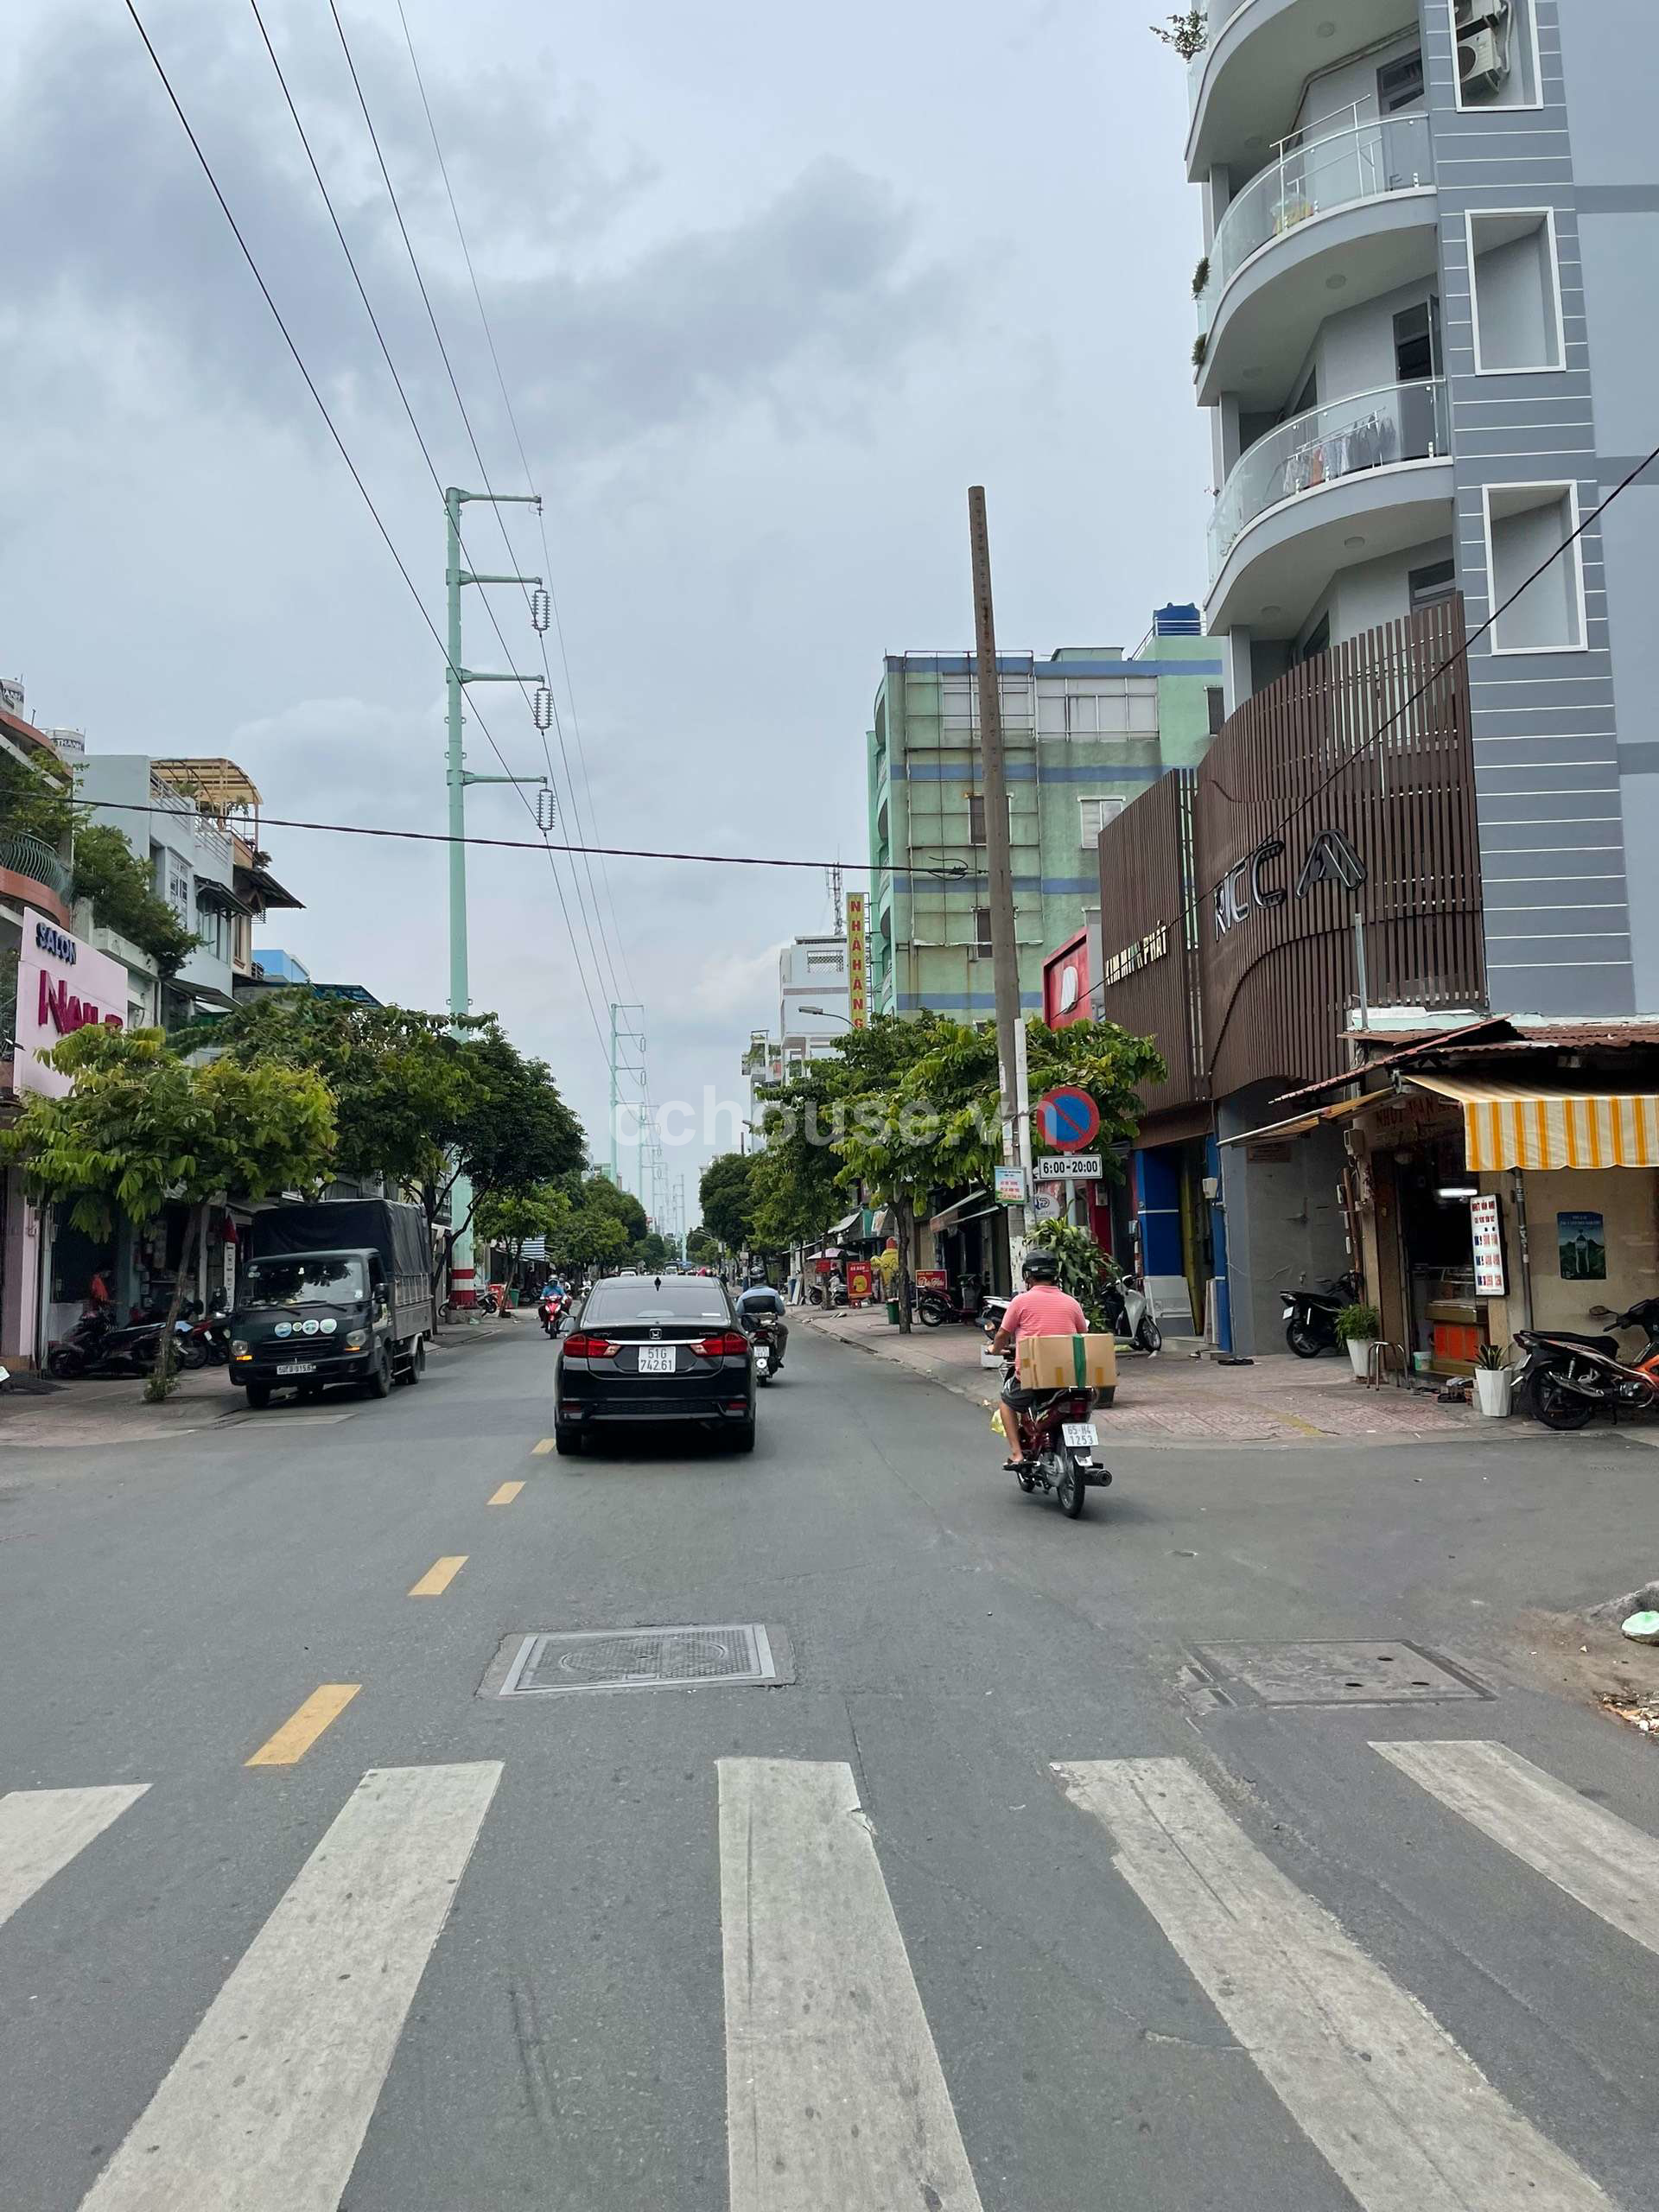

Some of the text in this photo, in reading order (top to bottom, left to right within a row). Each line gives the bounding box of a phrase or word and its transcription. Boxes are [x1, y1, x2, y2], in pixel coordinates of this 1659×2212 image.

[35, 922, 76, 965] SALON
[1143, 920, 1166, 965] PHÁT
[850, 900, 864, 1029] NHÀ HÀNG
[640, 1359, 672, 1370] 742.61
[648, 1348, 667, 1358] 51G
[1070, 1435, 1093, 1446] 1253
